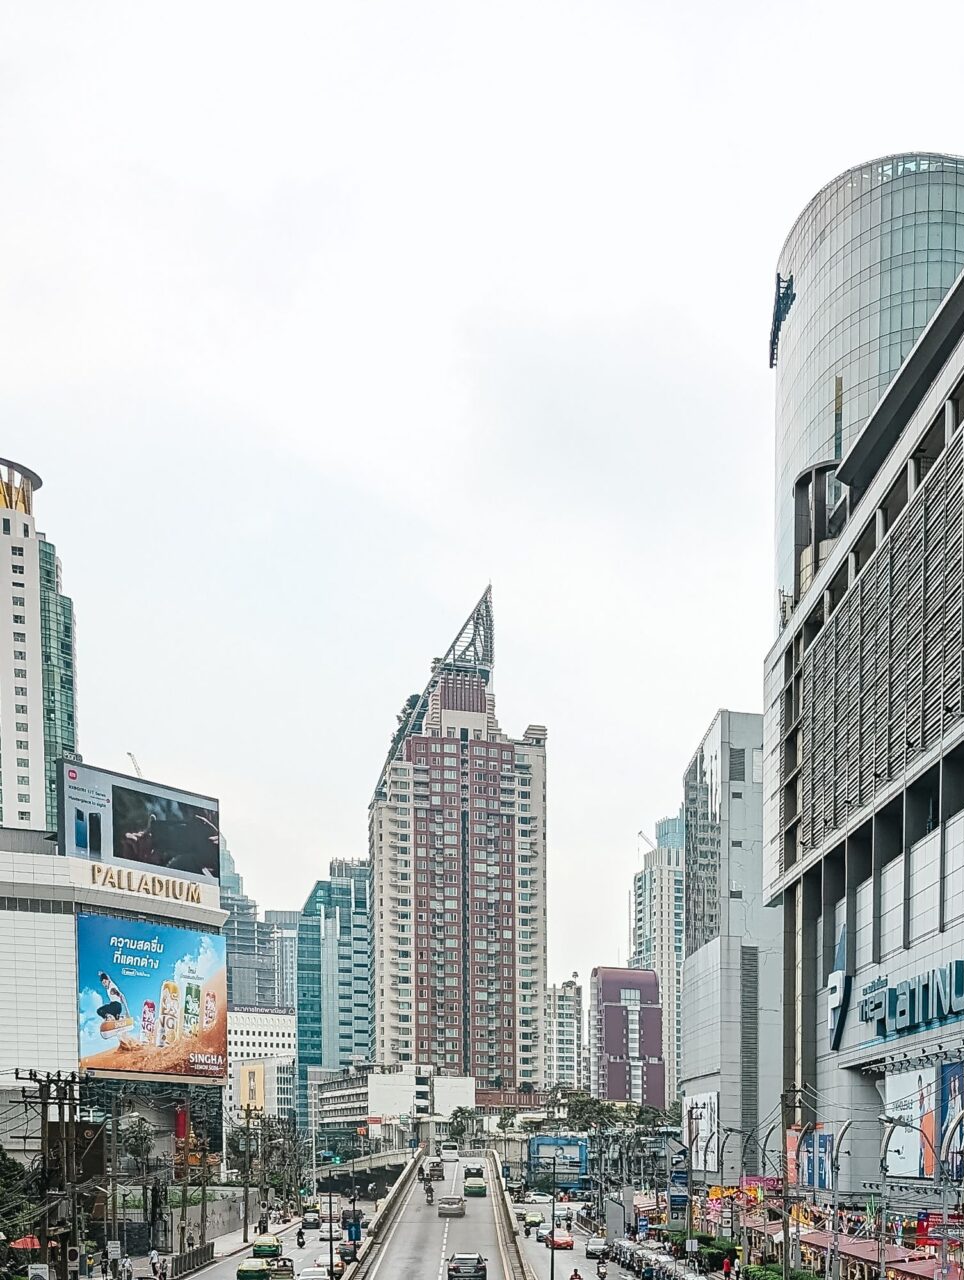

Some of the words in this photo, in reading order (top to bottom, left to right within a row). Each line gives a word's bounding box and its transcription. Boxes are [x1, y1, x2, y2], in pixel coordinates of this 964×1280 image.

[91, 864, 202, 904] PALLADIUM
[110, 936, 164, 953] ความสดชื่น
[113, 950, 159, 969] ที่แตกต่าง
[189, 1052, 223, 1065] SINGHA
